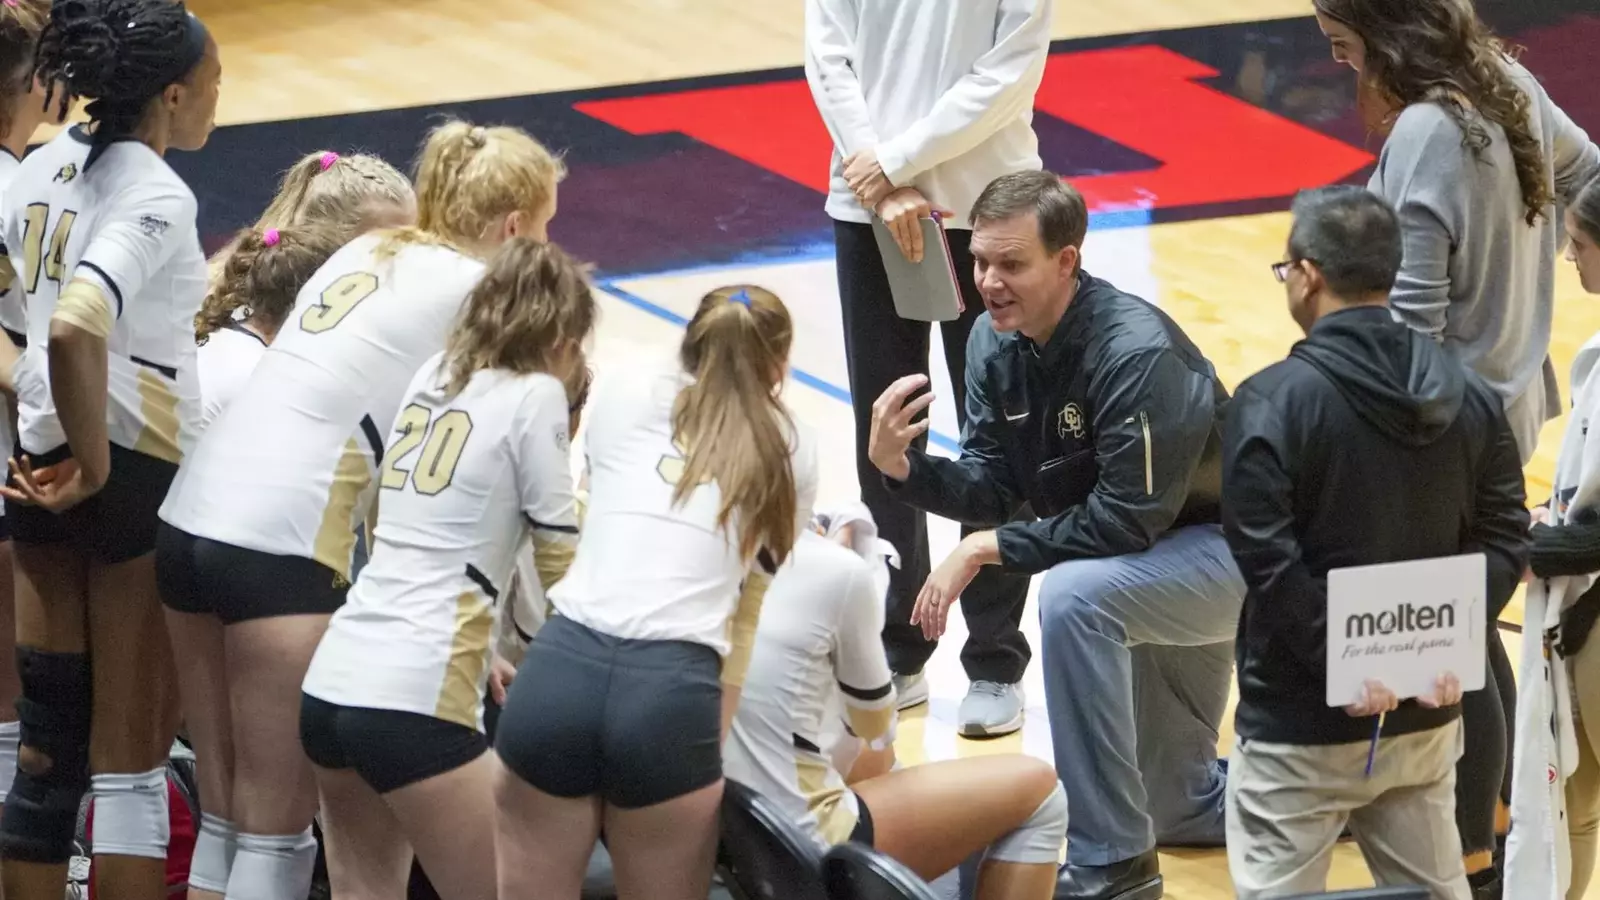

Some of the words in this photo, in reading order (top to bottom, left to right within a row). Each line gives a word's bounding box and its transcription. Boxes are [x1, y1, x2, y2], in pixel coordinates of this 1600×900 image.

[23, 202, 78, 298] 14
[300, 271, 378, 334] 9
[379, 402, 474, 496] 20
[1341, 644, 1361, 659] For
[1364, 642, 1385, 656] the
[1388, 638, 1416, 653] real
[1417, 637, 1454, 656] game
[1345, 603, 1454, 638] molten
